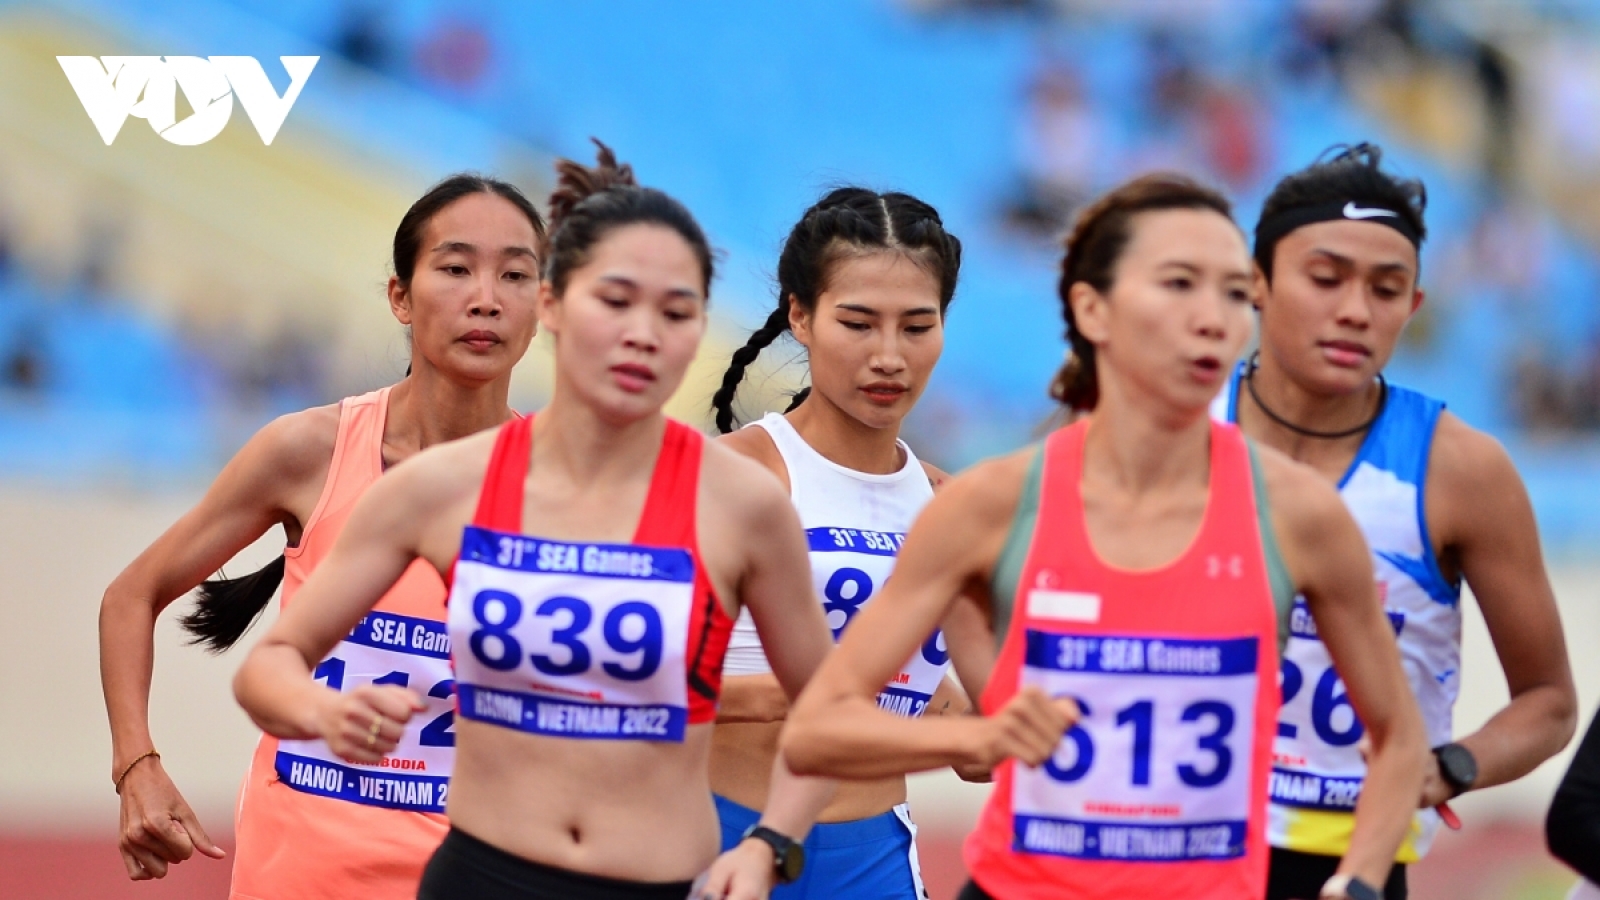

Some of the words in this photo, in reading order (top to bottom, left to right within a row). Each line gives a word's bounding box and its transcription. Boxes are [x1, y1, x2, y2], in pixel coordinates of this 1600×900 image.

[861, 531, 897, 552] SEA
[537, 542, 580, 571] SEA
[582, 545, 653, 577] Games
[371, 618, 406, 646] SEA
[469, 588, 664, 681] 839
[1100, 638, 1144, 672] SEA
[1147, 640, 1221, 674] Games
[537, 702, 621, 735] VIETNAM
[1042, 695, 1236, 790] 613
[290, 761, 343, 793] HANOI
[359, 775, 433, 806] VIETNAM
